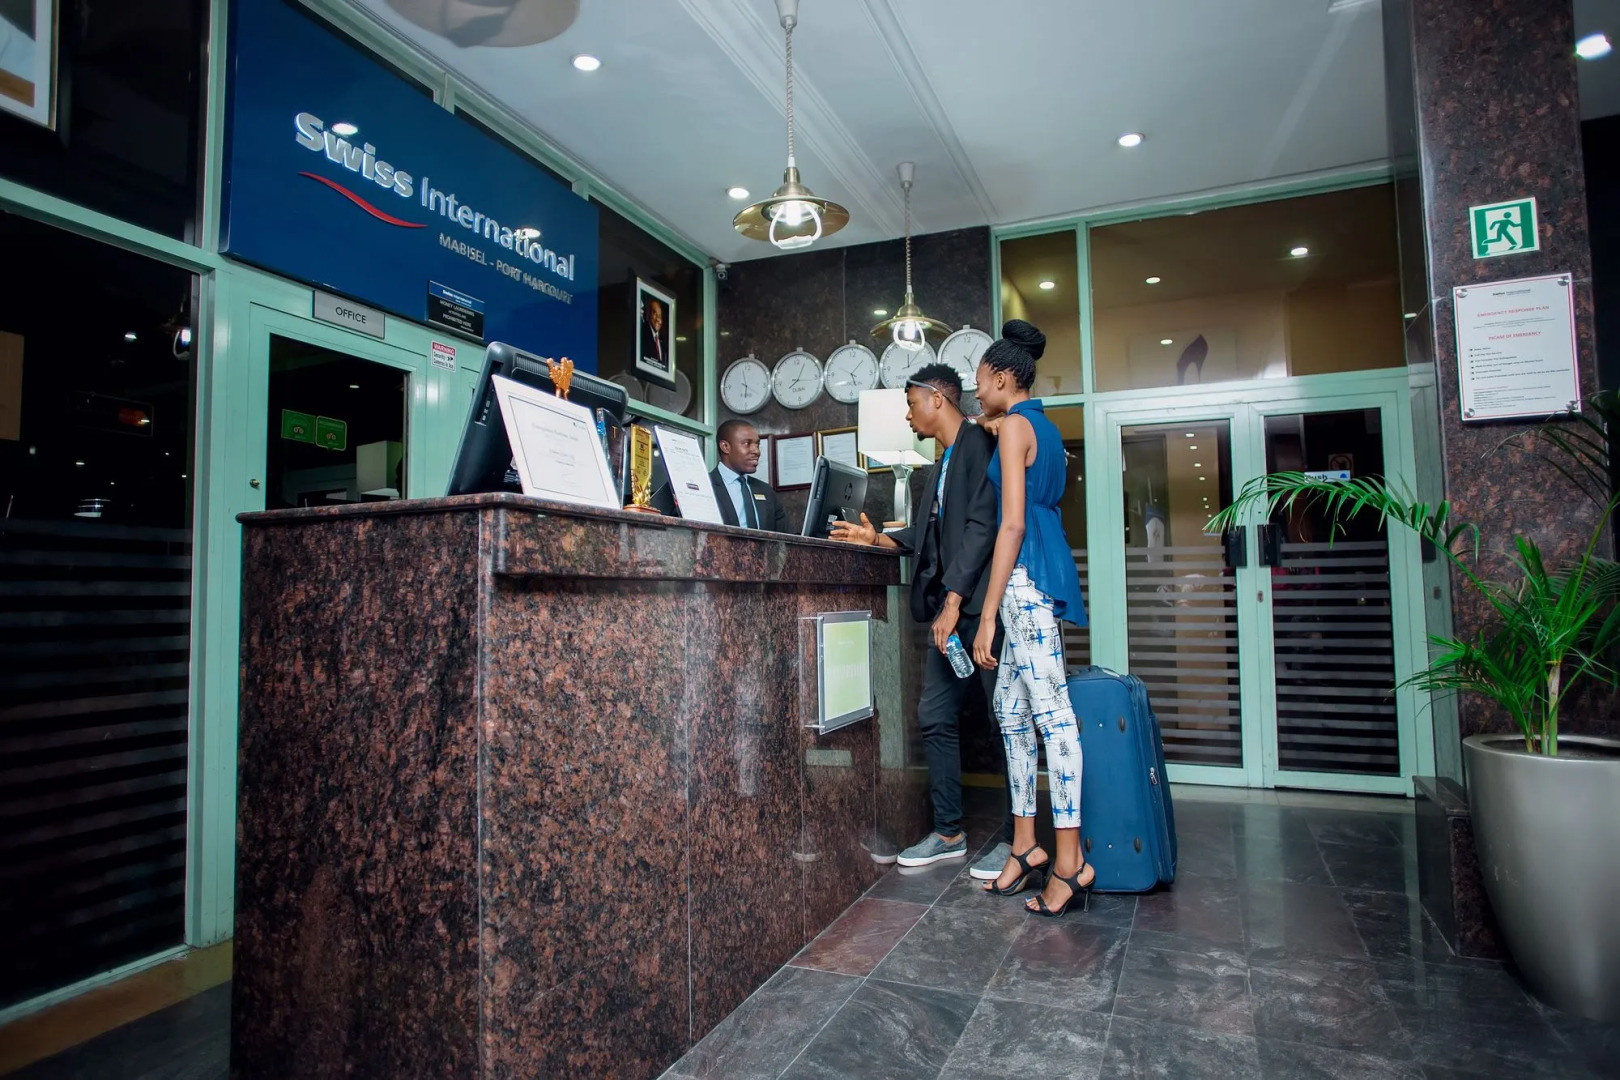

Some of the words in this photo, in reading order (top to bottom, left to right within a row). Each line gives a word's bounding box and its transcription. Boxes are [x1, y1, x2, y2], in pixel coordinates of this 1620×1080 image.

[296, 112, 414, 198] Swiss
[420, 176, 575, 281] International
[438, 232, 488, 267] MABISEL
[496, 258, 523, 283] PORT
[335, 306, 367, 325] OFFICE
